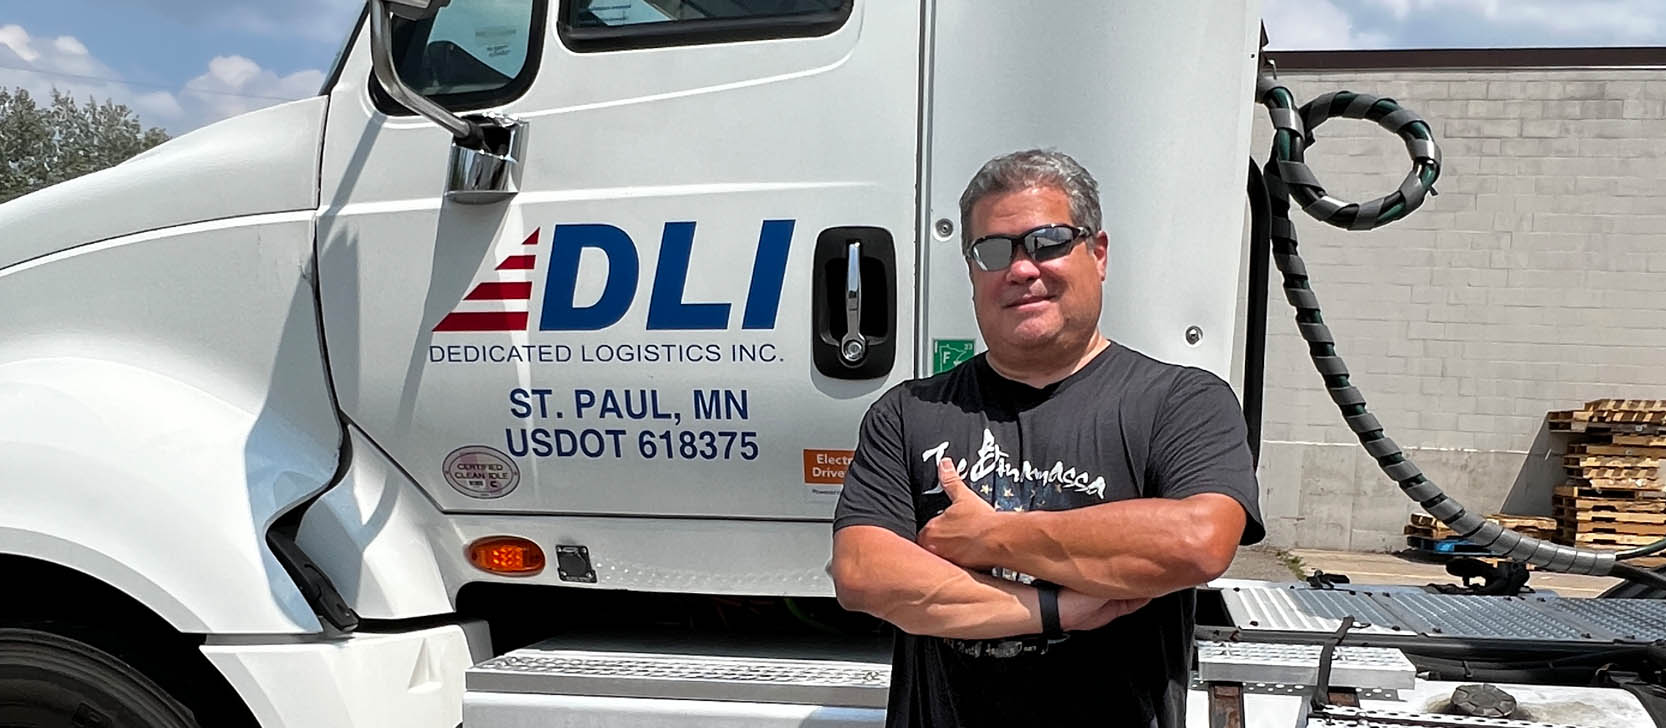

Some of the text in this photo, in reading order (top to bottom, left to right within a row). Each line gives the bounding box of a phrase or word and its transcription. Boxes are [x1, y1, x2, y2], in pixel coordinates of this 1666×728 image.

[539, 219, 795, 331] DLI
[429, 343, 784, 362] DEDICATED LOGISTICS INC.
[943, 351, 951, 364] F
[510, 388, 748, 426] ST. PAUL, MN
[505, 428, 758, 460] USDOT 618375
[816, 453, 854, 465] Electr
[454, 471, 509, 480] CLEAN IDLE
